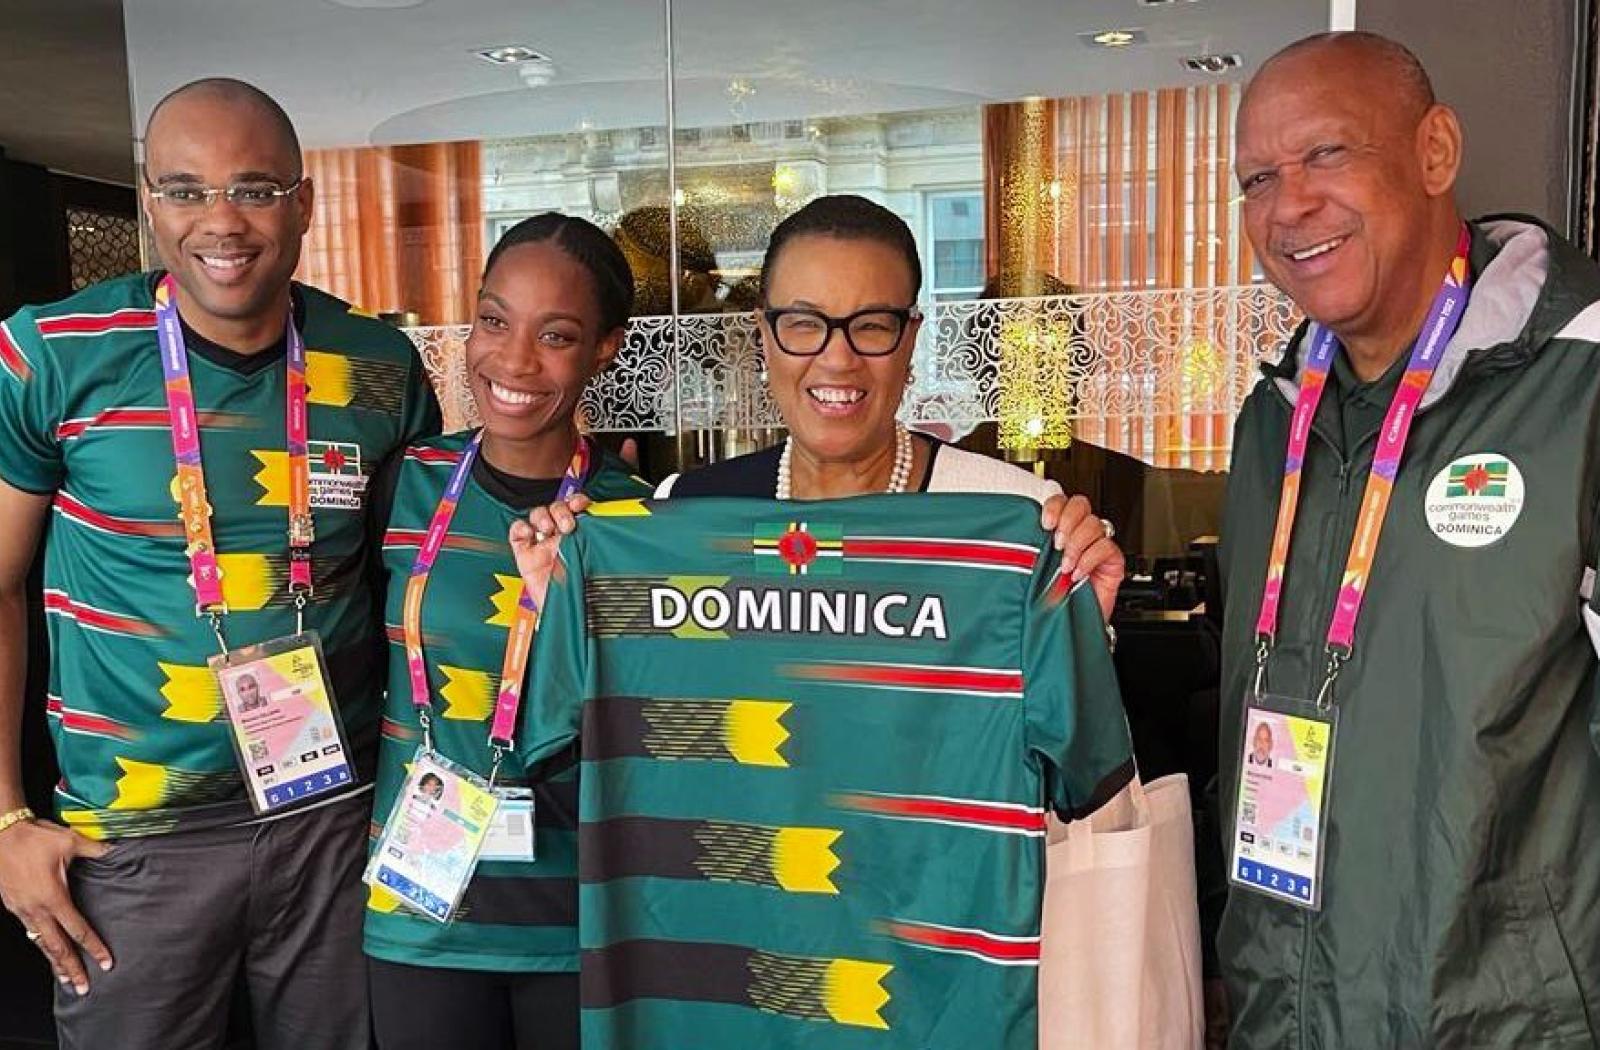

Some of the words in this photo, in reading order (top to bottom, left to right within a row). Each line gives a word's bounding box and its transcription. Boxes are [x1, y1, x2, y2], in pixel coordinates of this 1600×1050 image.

[1436, 523, 1503, 535] DOMINICA
[649, 586, 948, 640] DOMINICA
[304, 780, 313, 791] 2
[323, 774, 332, 785] 3
[1271, 872, 1279, 887] 2
[1287, 878, 1295, 892] 3
